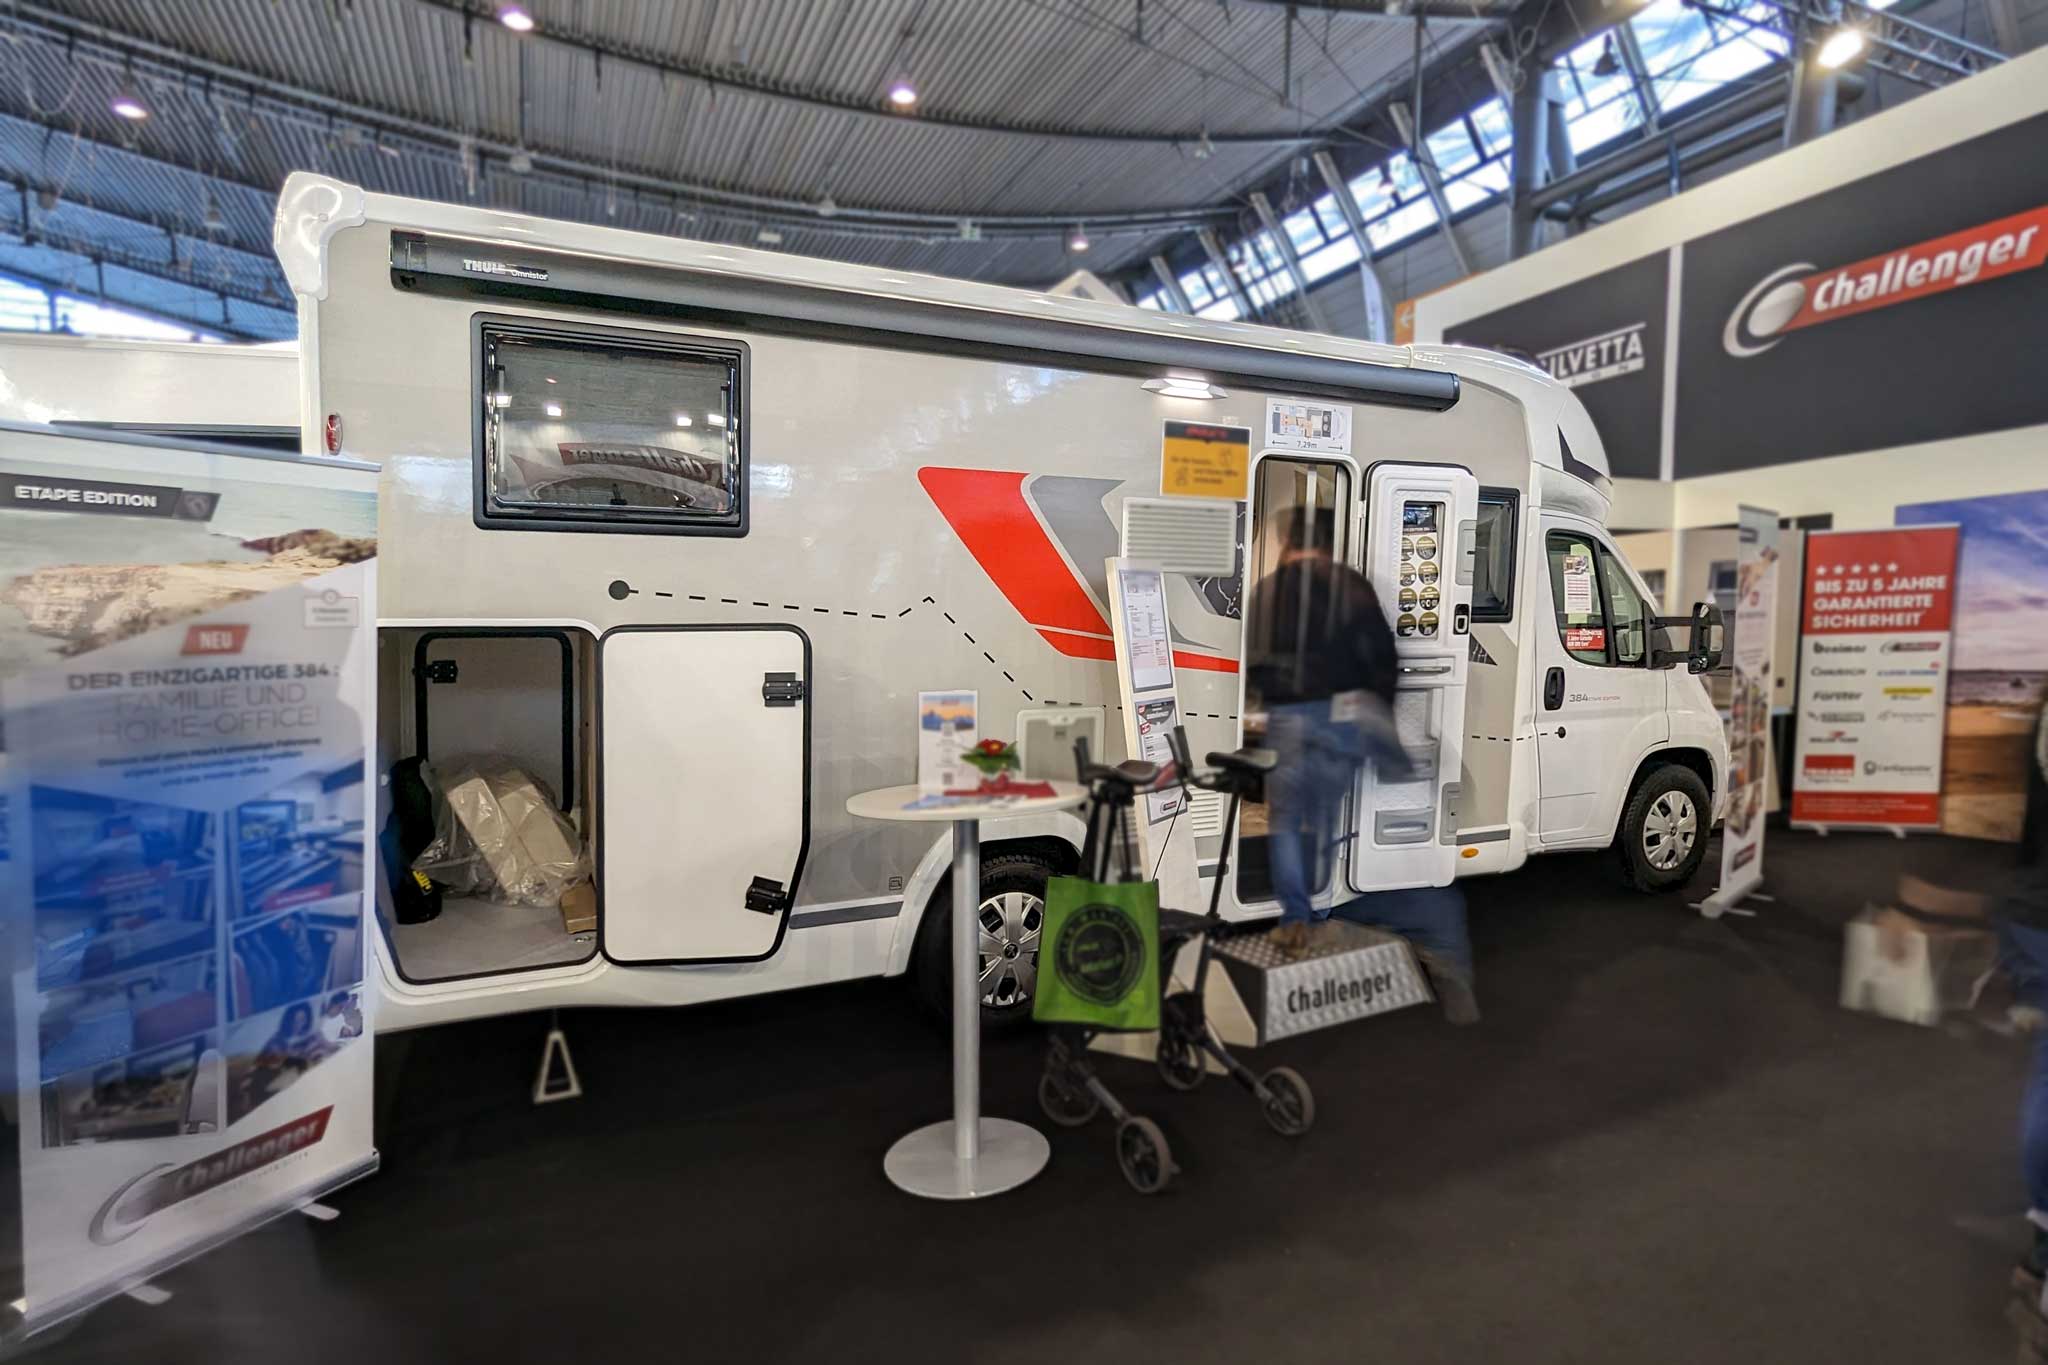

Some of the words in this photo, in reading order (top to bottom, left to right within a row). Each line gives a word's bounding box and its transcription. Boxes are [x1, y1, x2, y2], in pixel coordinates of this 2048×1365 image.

[511, 268, 549, 281] Omnistor
[1812, 225, 2040, 313] Challenger
[15, 485, 81, 502] ETAPE
[82, 491, 158, 508] EDITION
[1814, 579, 1842, 594] BIS
[1844, 577, 1869, 593] ZU
[1887, 574, 1947, 592] JAHRE
[1813, 593, 1933, 612] GARANTIERTE
[199, 629, 233, 650] NEU
[67, 672, 122, 691] DER
[129, 664, 289, 688] EINZIGARTIGE
[245, 683, 307, 707] UND
[1569, 694, 1588, 703] 384
[1287, 971, 1392, 1014] Challenger
